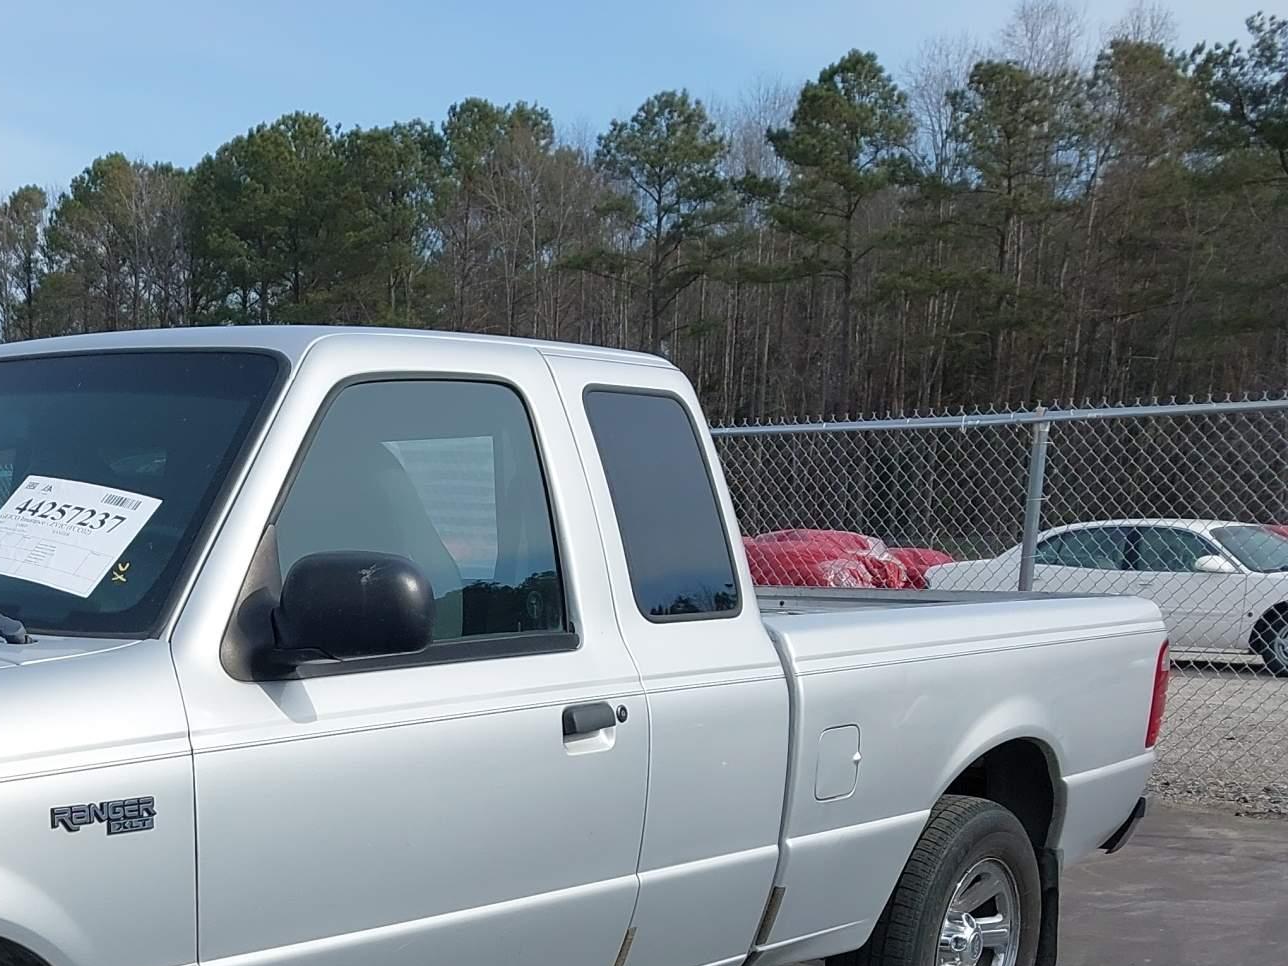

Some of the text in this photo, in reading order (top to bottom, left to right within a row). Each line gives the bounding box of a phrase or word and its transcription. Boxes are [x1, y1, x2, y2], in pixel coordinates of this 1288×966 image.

[15, 497, 127, 533] 44257237
[51, 796, 157, 832] RANGER
[111, 818, 151, 833] XLT
